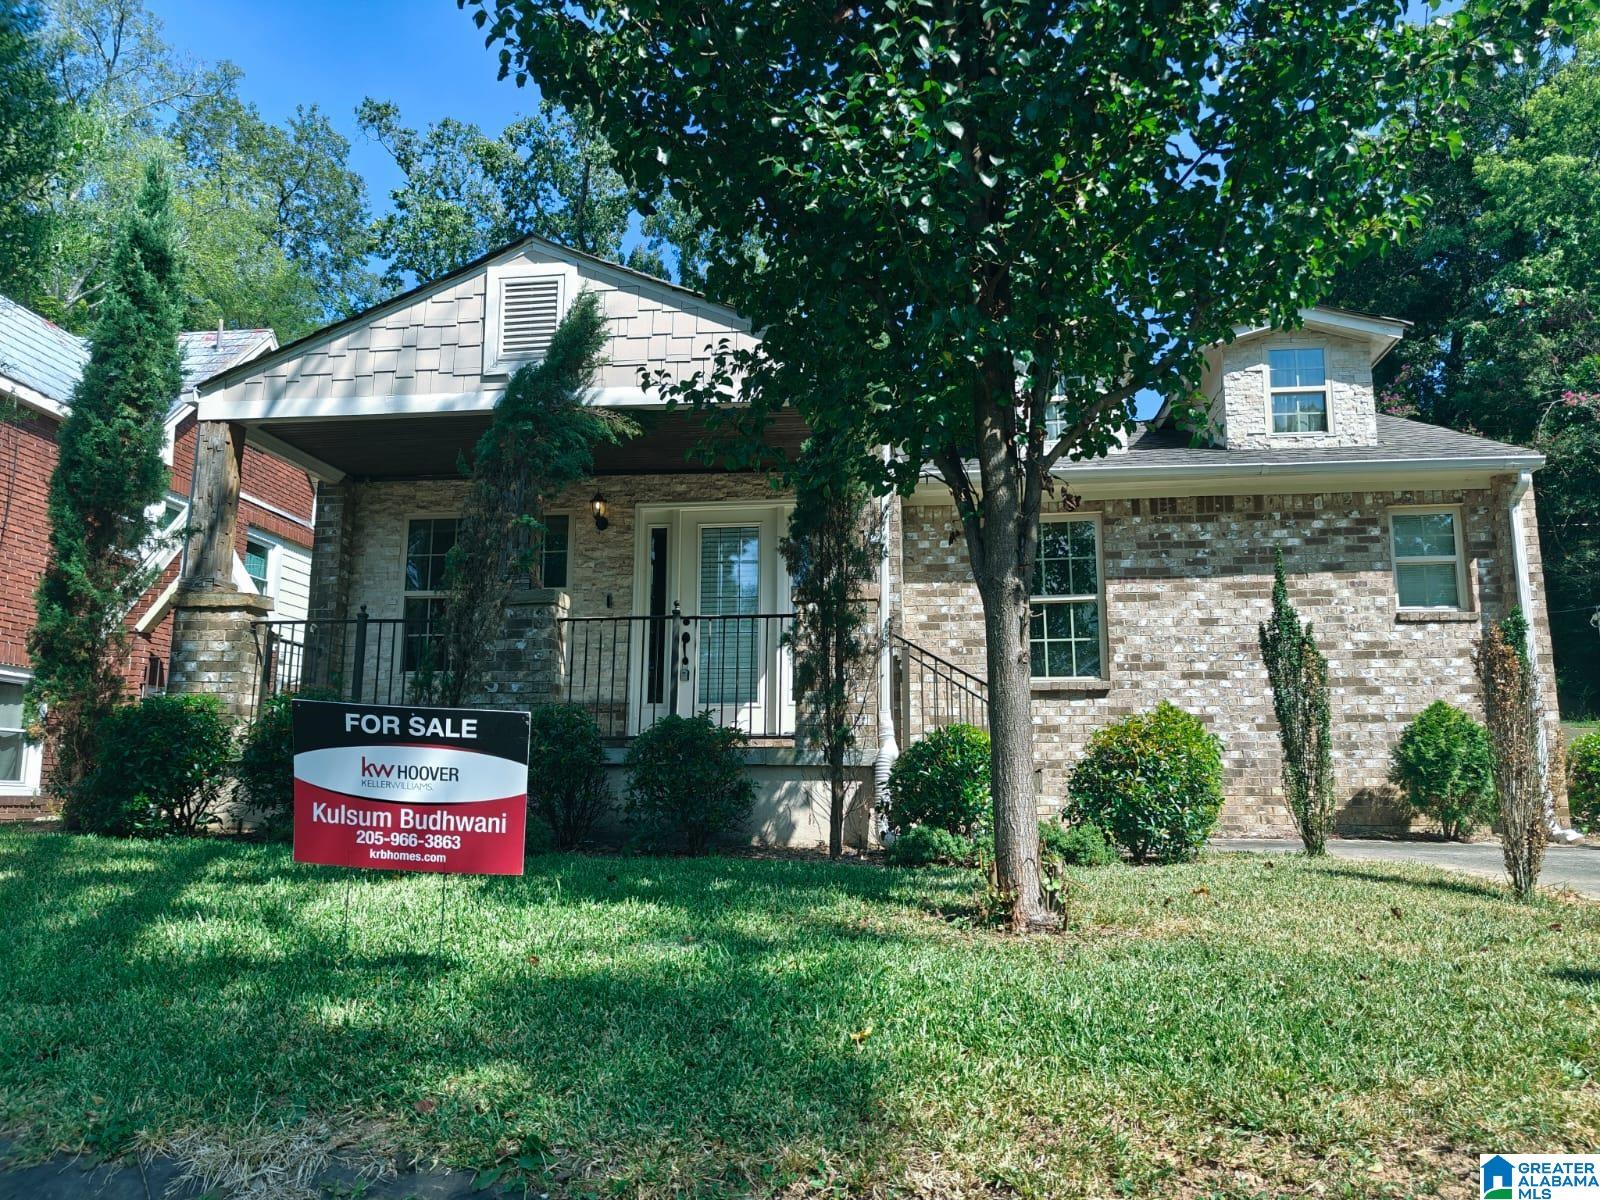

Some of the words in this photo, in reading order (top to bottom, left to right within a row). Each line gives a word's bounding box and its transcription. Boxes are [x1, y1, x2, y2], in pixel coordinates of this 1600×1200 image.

[345, 713, 400, 735] FOR
[408, 716, 478, 739] SALE
[361, 756, 395, 779] kw
[397, 764, 459, 782] HOOVER
[312, 802, 392, 828] Kulsum
[400, 808, 507, 834] Budhwani
[356, 830, 461, 850] 205-966-3863
[369, 849, 447, 863] krbhomes.com
